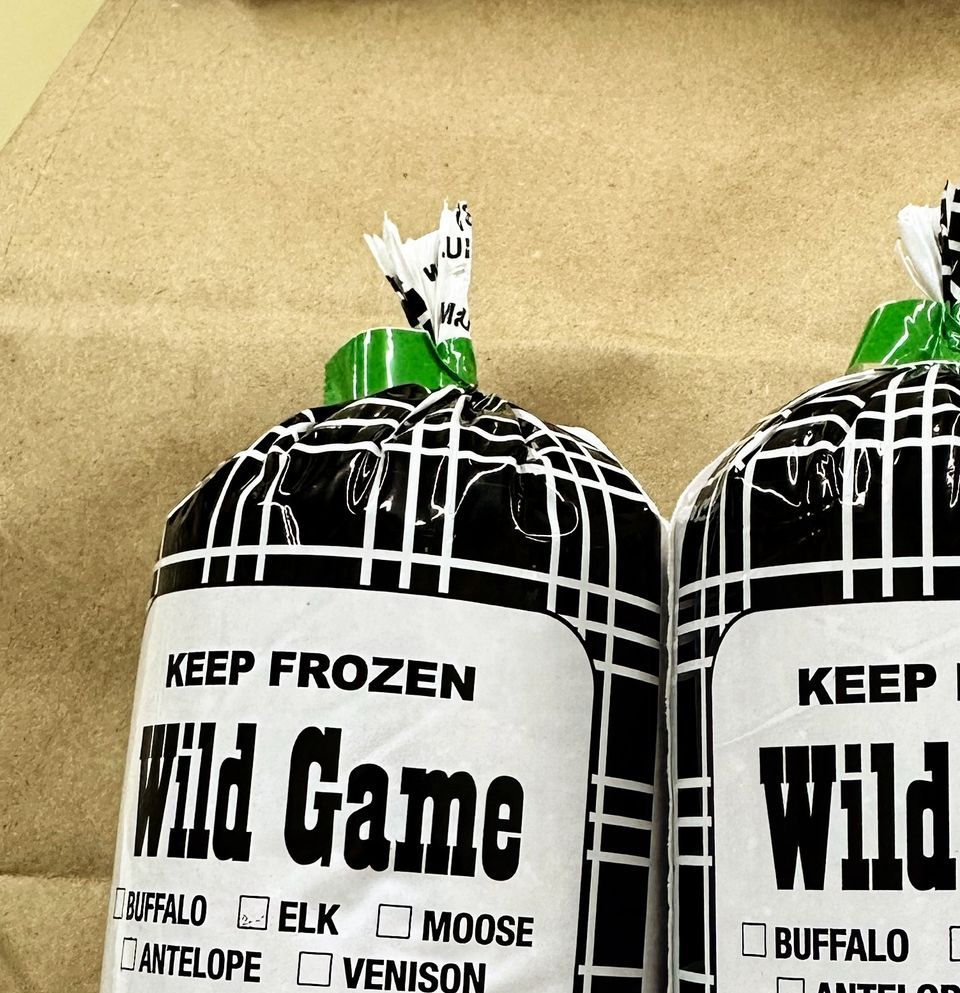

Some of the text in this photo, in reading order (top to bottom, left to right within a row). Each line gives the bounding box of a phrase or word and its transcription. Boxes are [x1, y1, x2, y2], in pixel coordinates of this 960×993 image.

[166, 651, 475, 701] KEEP FROZEN
[799, 664, 936, 706] KEEP
[134, 723, 523, 881] Wild Game
[759, 742, 956, 891] Wild
[126, 891, 534, 947] BUFFALO ELK MOOSE
[139, 943, 261, 982] ANTELOPE
[775, 927, 908, 962] BUFFALO
